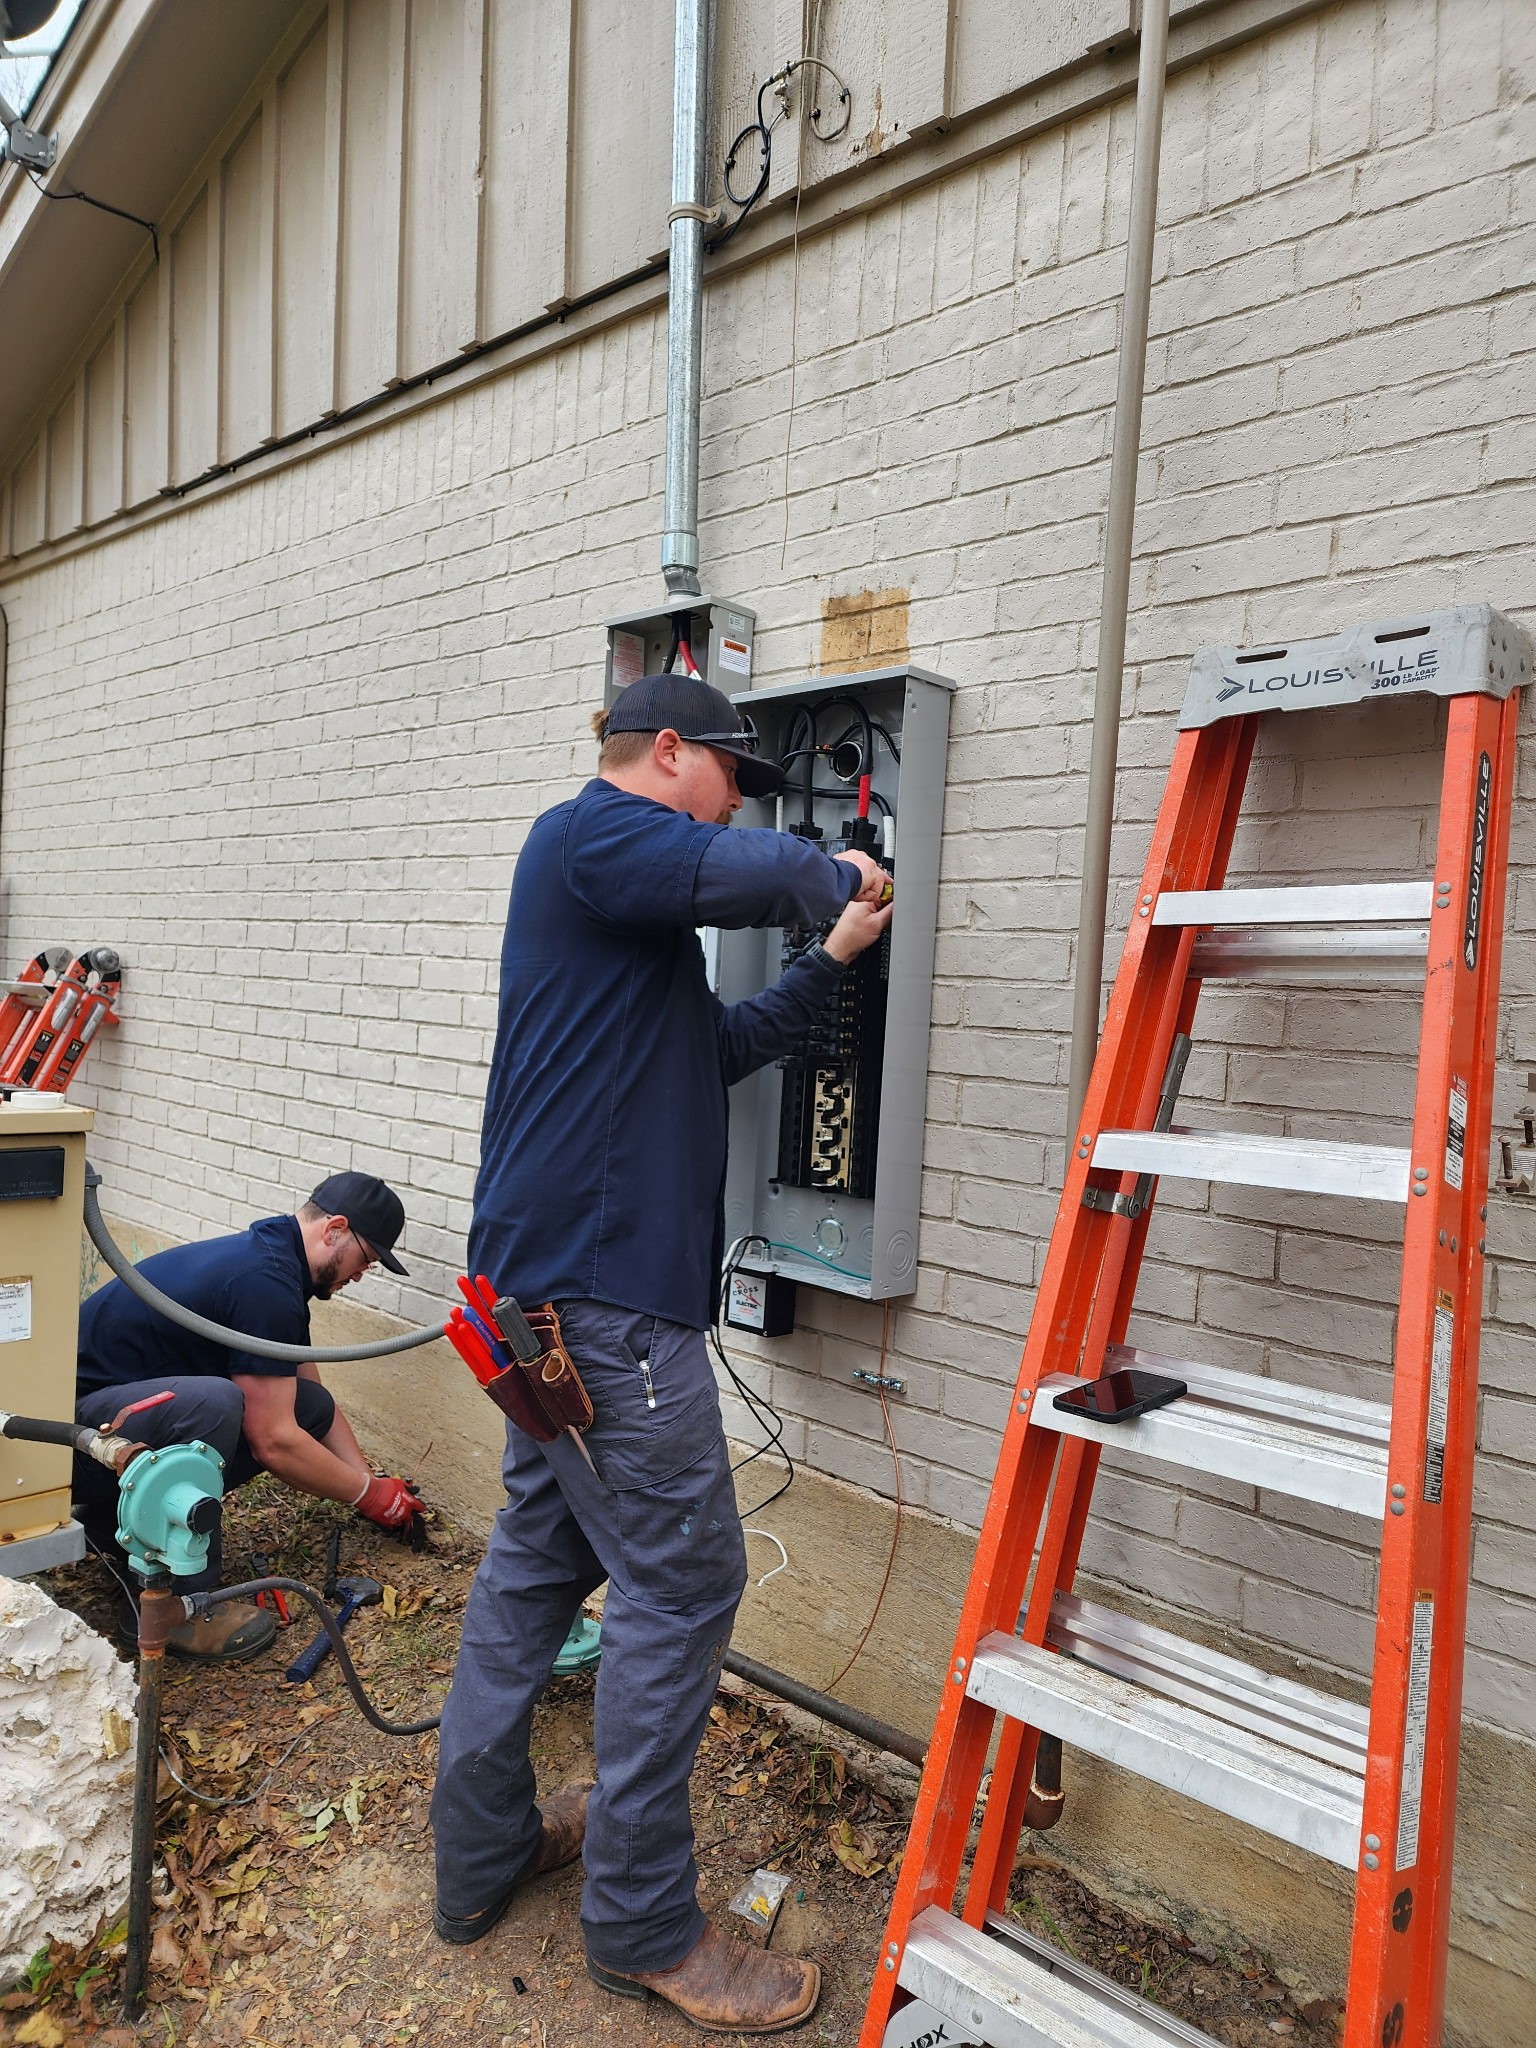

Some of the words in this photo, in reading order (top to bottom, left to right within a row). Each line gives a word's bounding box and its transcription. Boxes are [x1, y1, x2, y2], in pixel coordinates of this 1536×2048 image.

[1370, 675, 1400, 689] 300
[1402, 673, 1437, 684] CAPACITY
[1469, 762, 1490, 938] LOUISVILLE
